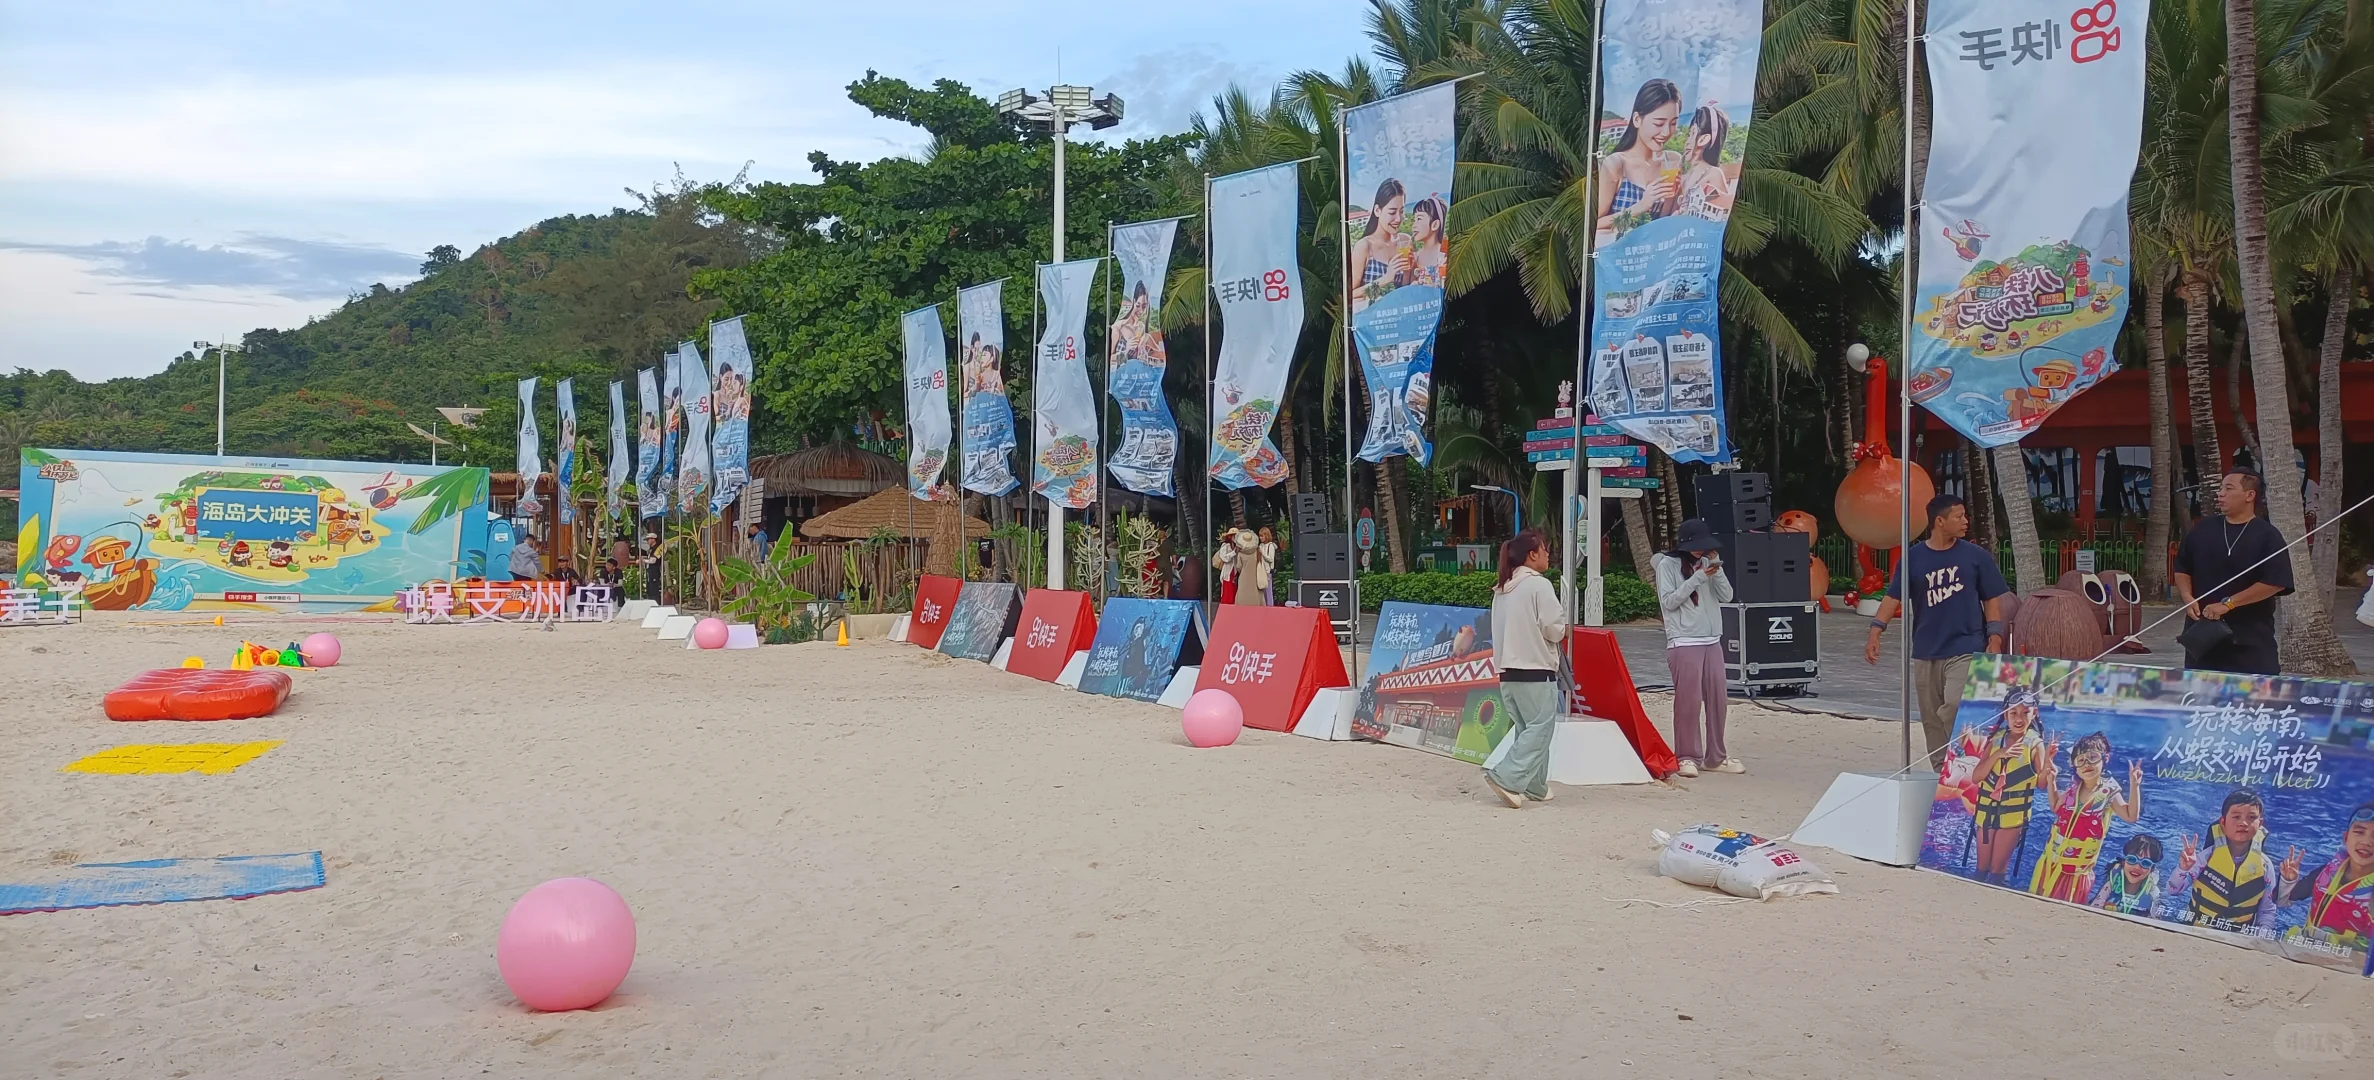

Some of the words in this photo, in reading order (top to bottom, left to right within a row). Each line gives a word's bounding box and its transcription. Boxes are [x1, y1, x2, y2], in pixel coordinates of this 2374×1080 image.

[202, 501, 311, 526] 海岛大冲关
[0, 587, 86, 623] 亲子
[405, 582, 614, 623] 蜈支洲岛
[927, 603, 942, 624] 快手
[1038, 623, 1058, 648] 快手
[1241, 651, 1277, 684] 快手
[2153, 736, 2322, 786] 从蜈支洲岛开始
[2156, 764, 2264, 785] Wuzhizhou
